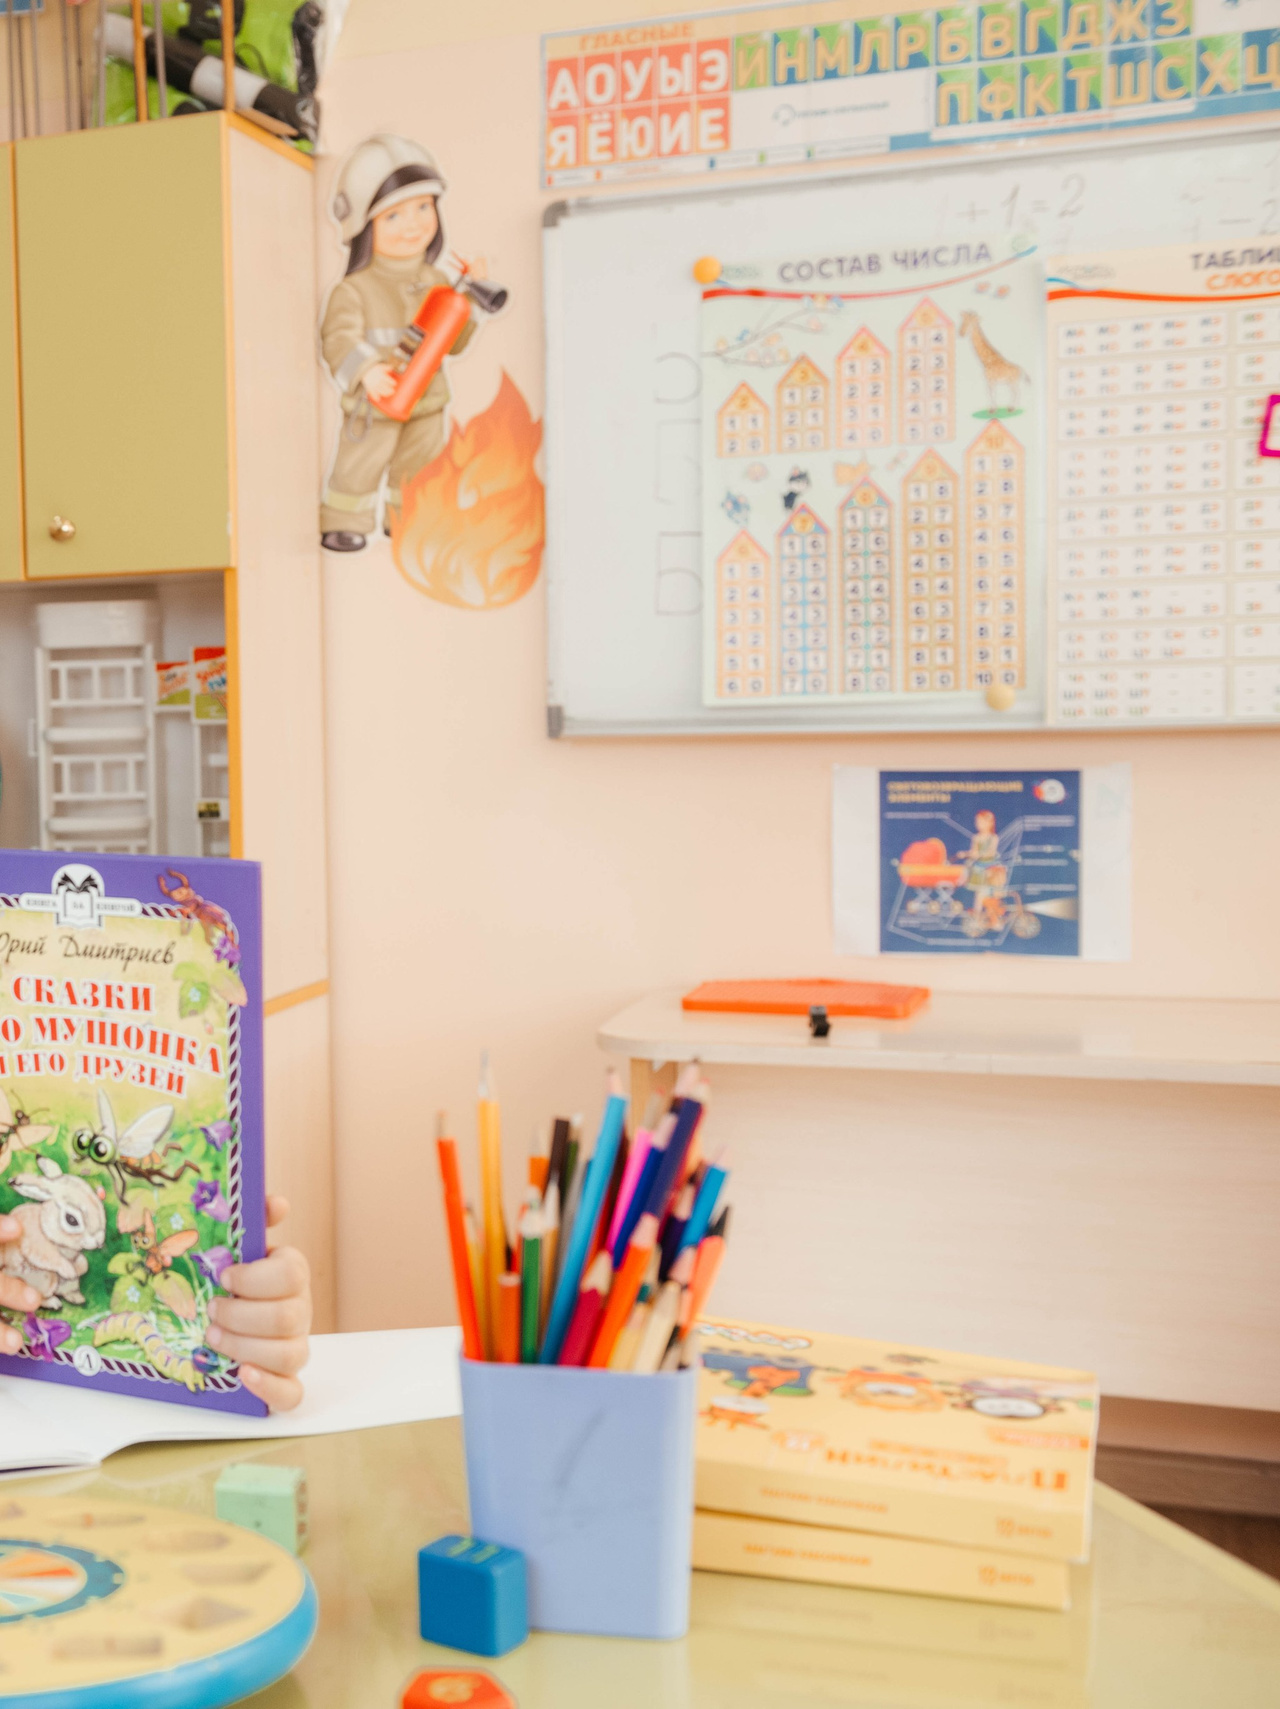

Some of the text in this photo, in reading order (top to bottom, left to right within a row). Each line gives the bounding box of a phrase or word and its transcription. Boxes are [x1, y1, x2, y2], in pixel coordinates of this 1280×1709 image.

[578, 23, 695, 50] ГЛАСНЫЕ
[777, 253, 882, 284] СОСТАВ
[891, 242, 993, 270] ЧИСЛА
[58, 934, 176, 972] Дмитриев
[12, 976, 152, 1012] СКАЗКИ
[33, 1016, 223, 1075] МУШОНКА
[17, 1053, 66, 1074] ЕГО
[75, 1054, 185, 1096] ДРУЗЕЙ
